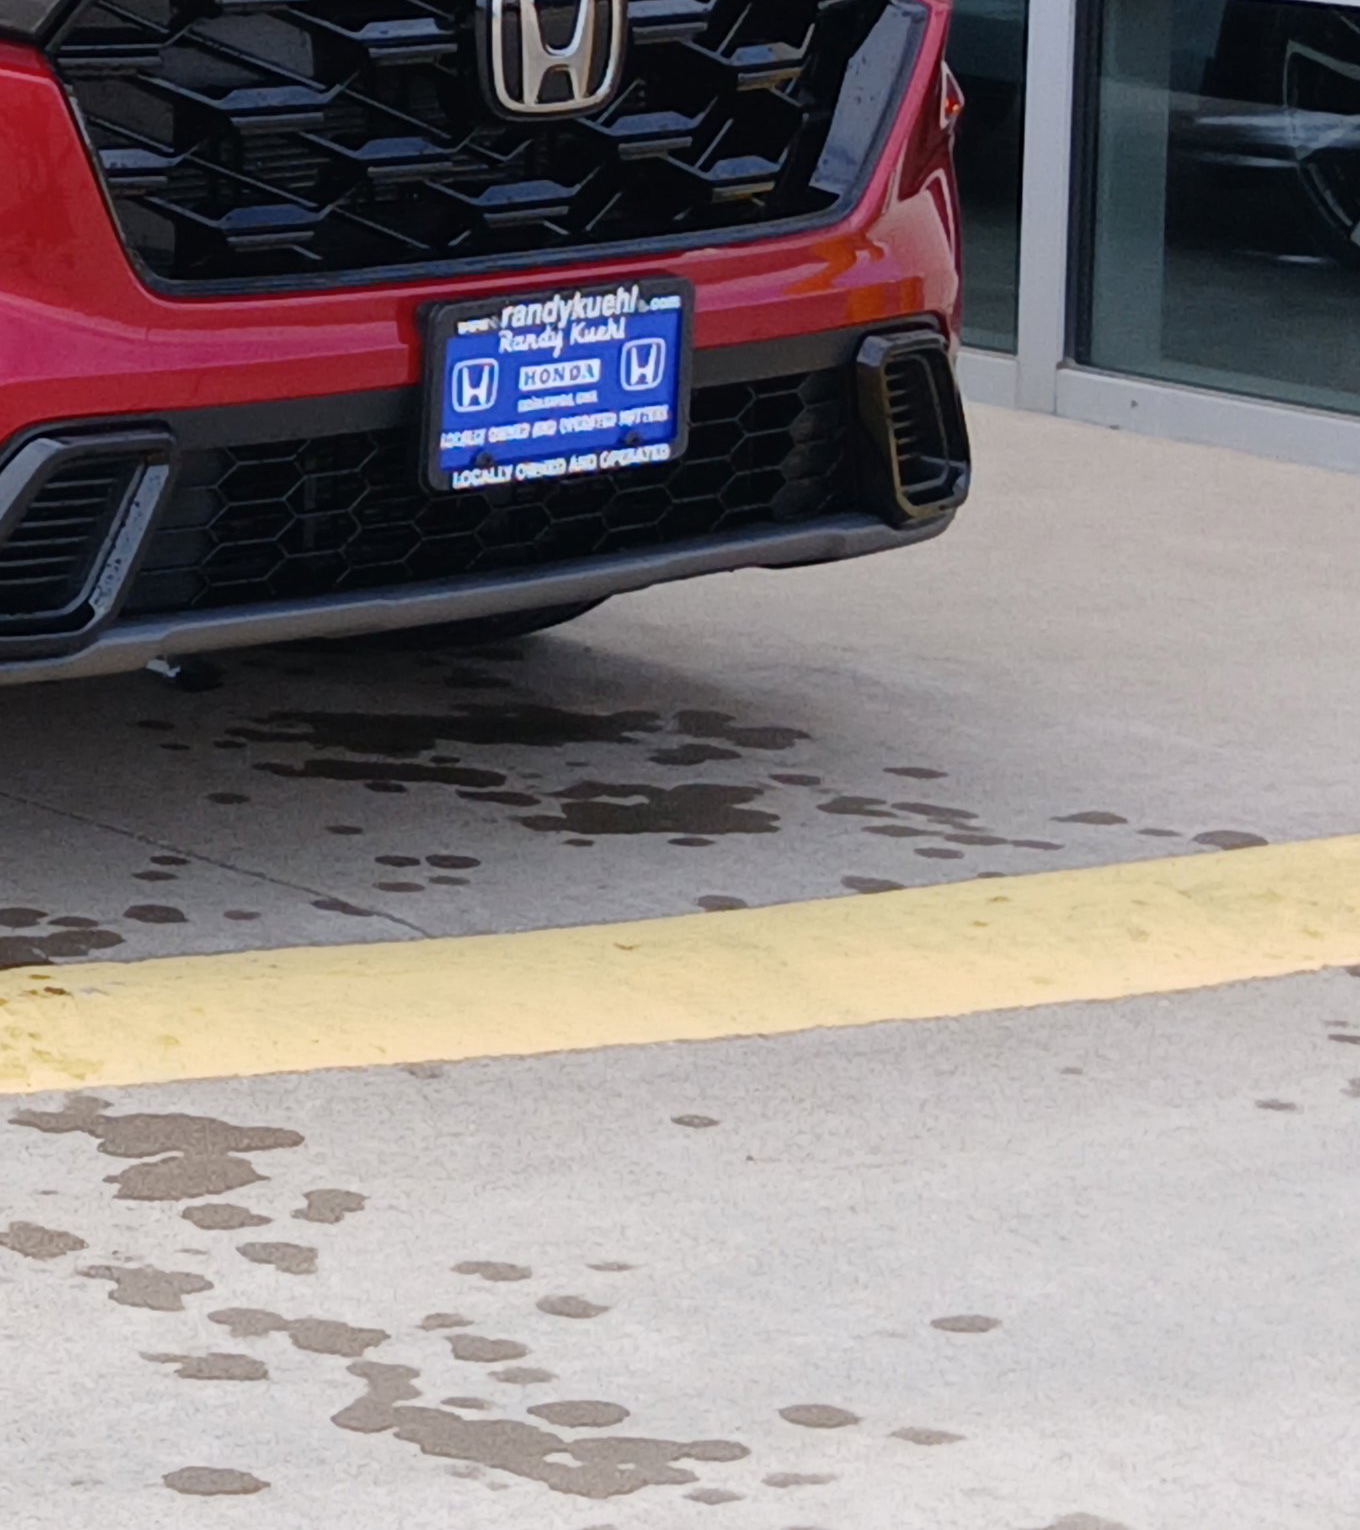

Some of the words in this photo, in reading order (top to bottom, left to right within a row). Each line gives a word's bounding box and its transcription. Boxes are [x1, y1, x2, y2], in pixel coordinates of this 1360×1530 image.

[498, 324, 563, 358] Randy
[570, 316, 625, 346] Kuehl
[524, 363, 595, 387] HONDA
[452, 464, 513, 490] LOCALLY
[568, 454, 597, 473] AND
